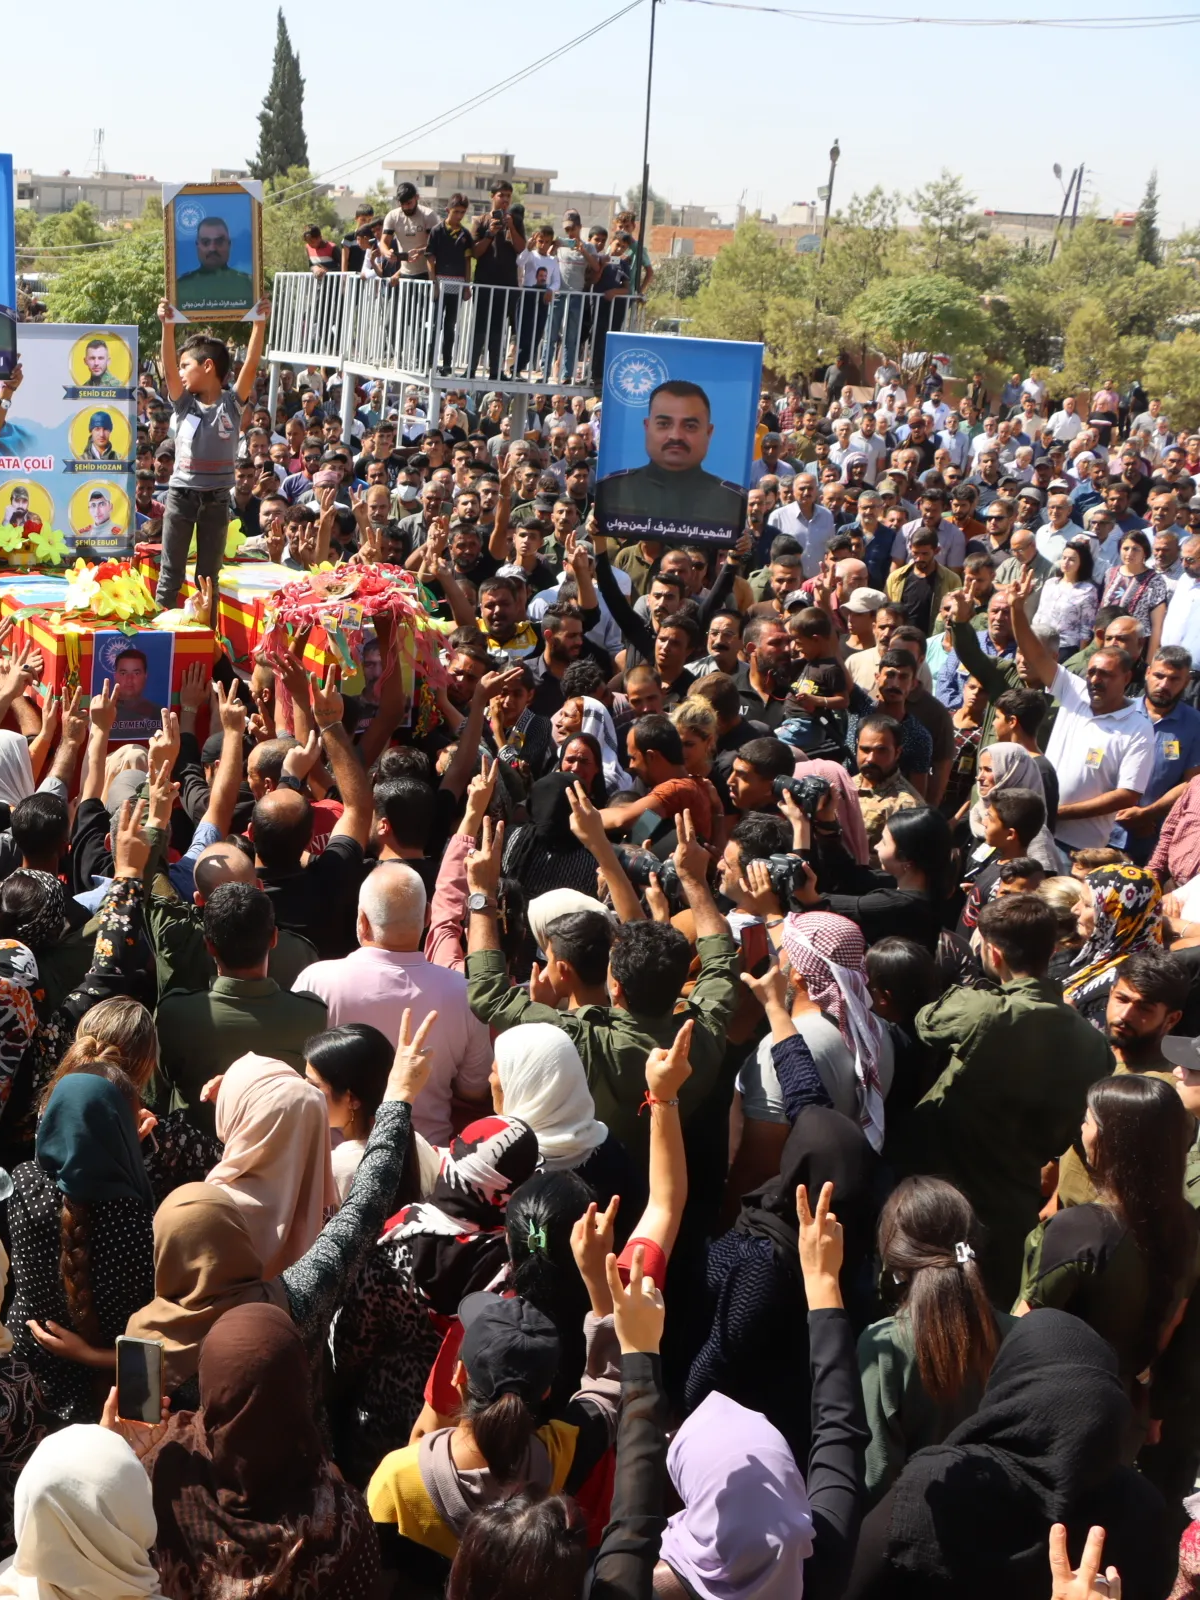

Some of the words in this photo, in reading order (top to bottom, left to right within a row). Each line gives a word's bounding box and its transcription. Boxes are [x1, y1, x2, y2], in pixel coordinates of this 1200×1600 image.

[606, 519, 629, 531] جولي
[629, 518, 652, 532] أيمن
[676, 524, 698, 537] الرائد
[699, 528, 732, 538] الشهيد
